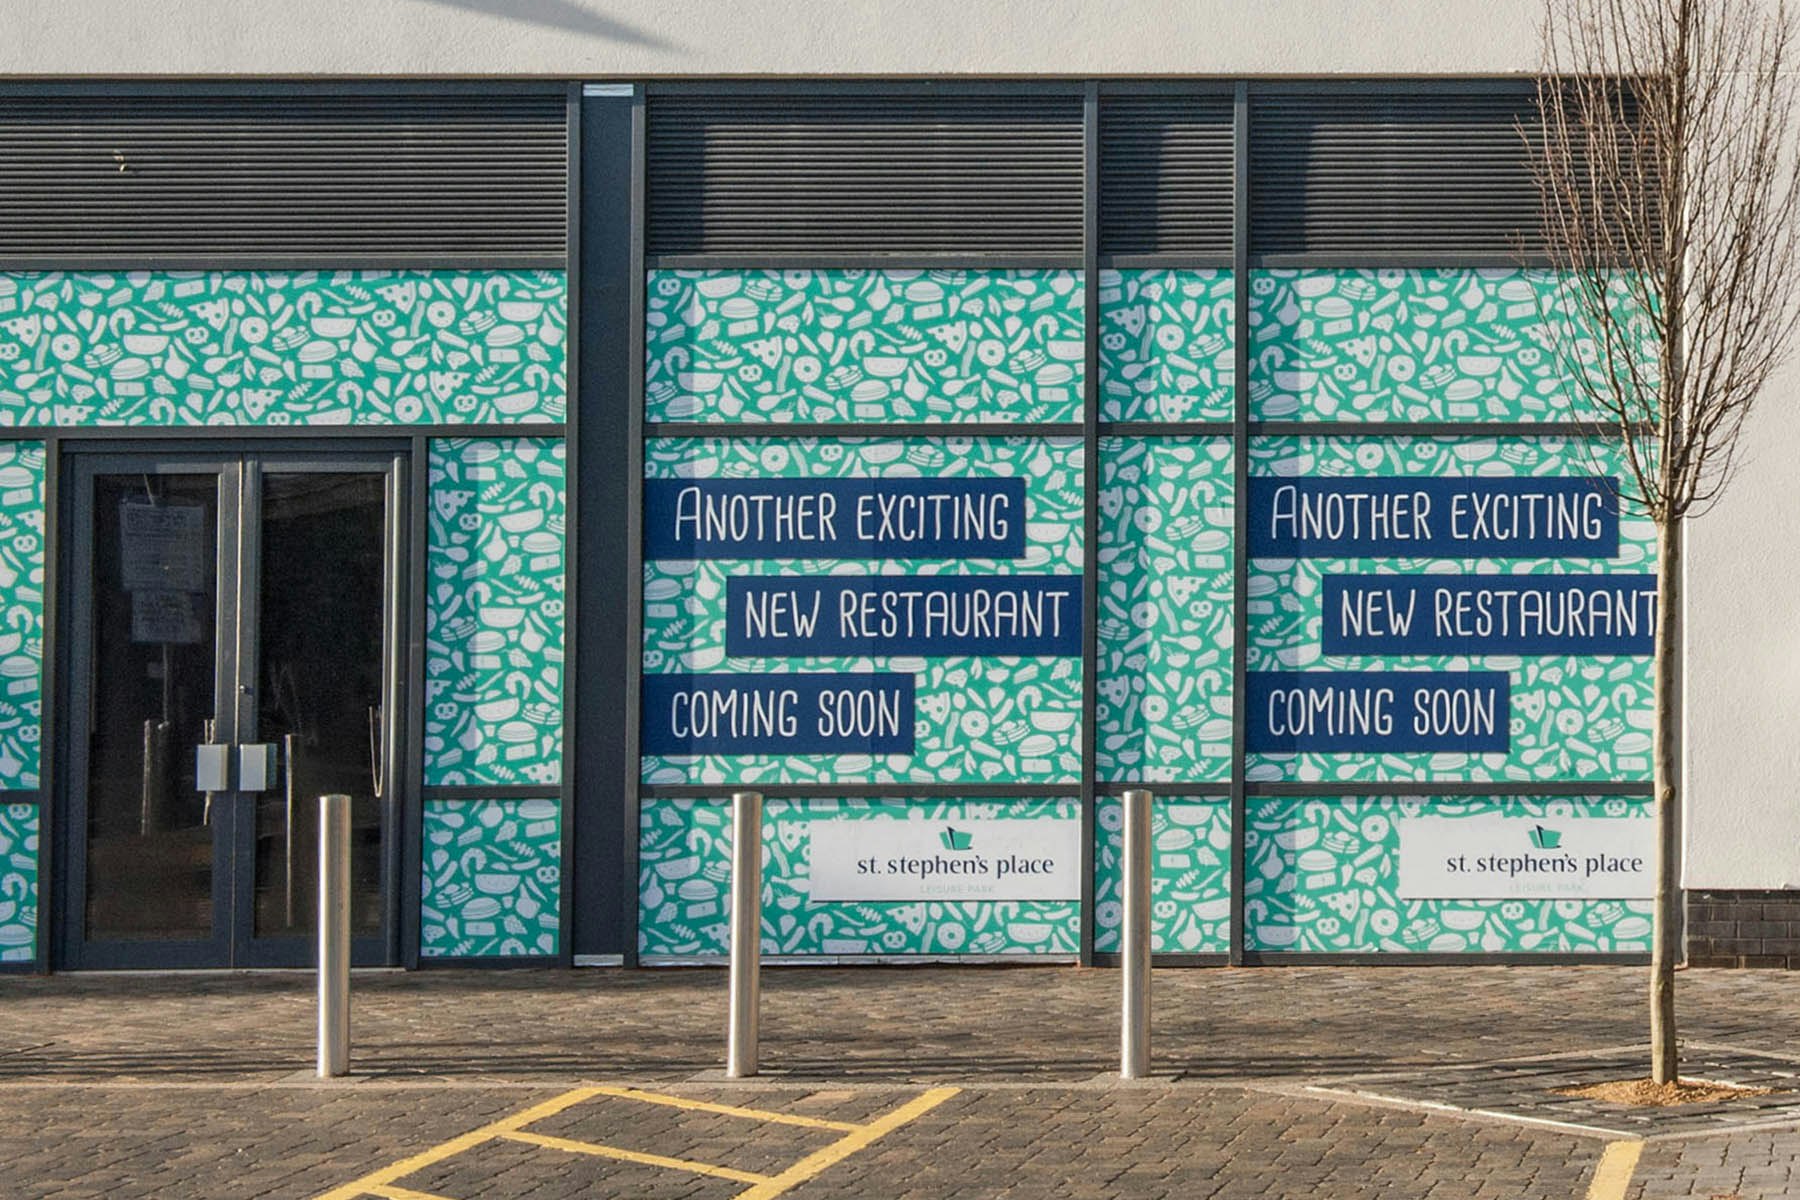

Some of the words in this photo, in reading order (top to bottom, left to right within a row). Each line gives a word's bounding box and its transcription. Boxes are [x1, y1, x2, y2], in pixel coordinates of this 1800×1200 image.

[675, 486, 837, 542] ANOTHER
[857, 493, 1009, 542] EXCITING
[1272, 485, 1432, 541] ANOTHER
[1451, 492, 1602, 541] EXCITING
[745, 590, 821, 639] NEW
[840, 589, 1069, 638] RESTAURANT
[1342, 589, 1416, 637] NEW
[1436, 589, 1658, 637] RESTAURANT
[672, 688, 798, 738] COMING
[818, 689, 900, 737] SOON
[1269, 687, 1394, 736] COMING
[1413, 688, 1495, 736] SOON
[857, 857, 882, 875] st.
[887, 855, 989, 880] stephen's
[997, 855, 1054, 880] place
[1447, 855, 1471, 873] st.
[1476, 853, 1578, 878] stephen's
[1585, 853, 1643, 878] place
